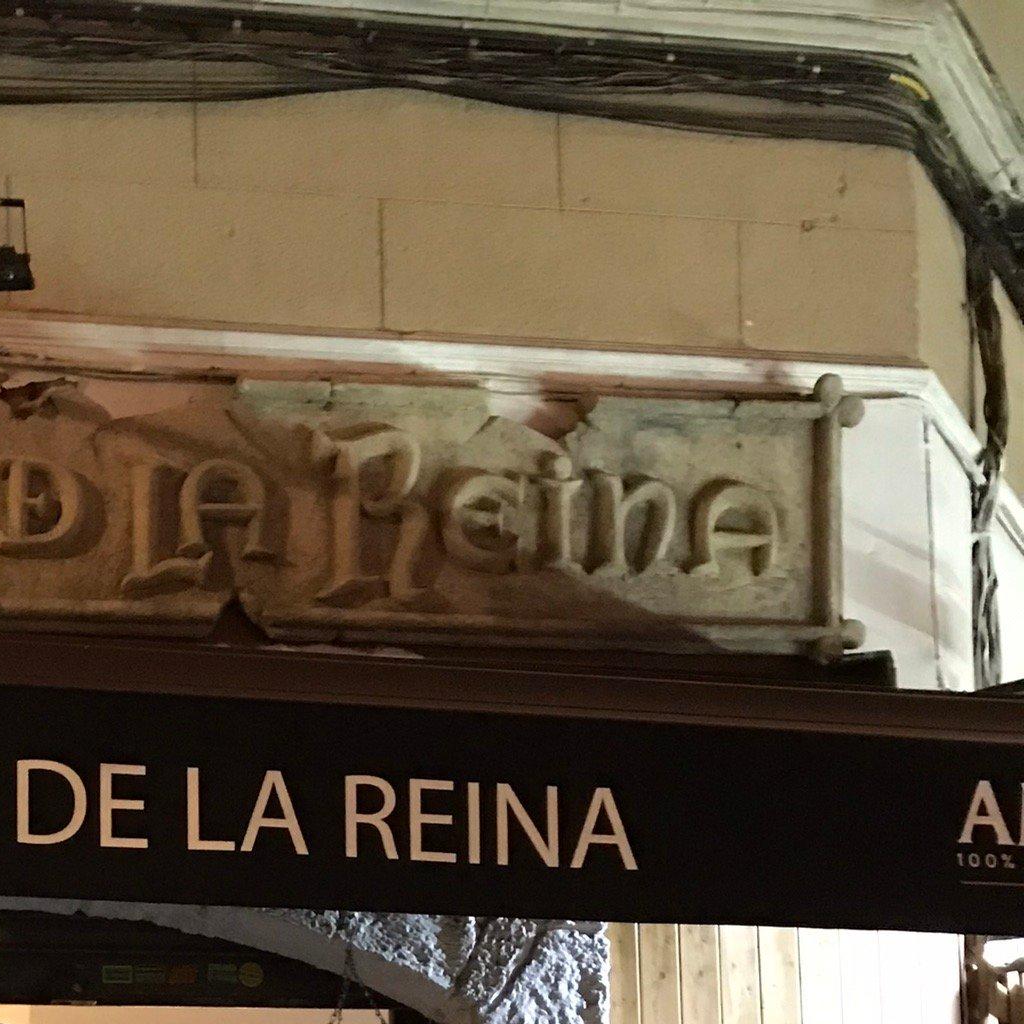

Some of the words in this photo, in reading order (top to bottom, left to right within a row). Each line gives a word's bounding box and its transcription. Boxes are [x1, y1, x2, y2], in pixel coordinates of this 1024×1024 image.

[16, 759, 149, 849] DE
[186, 766, 309, 855] LA
[344, 774, 638, 871] REINA
[958, 780, 1024, 847] A
[957, 853, 1015, 869] 100%
